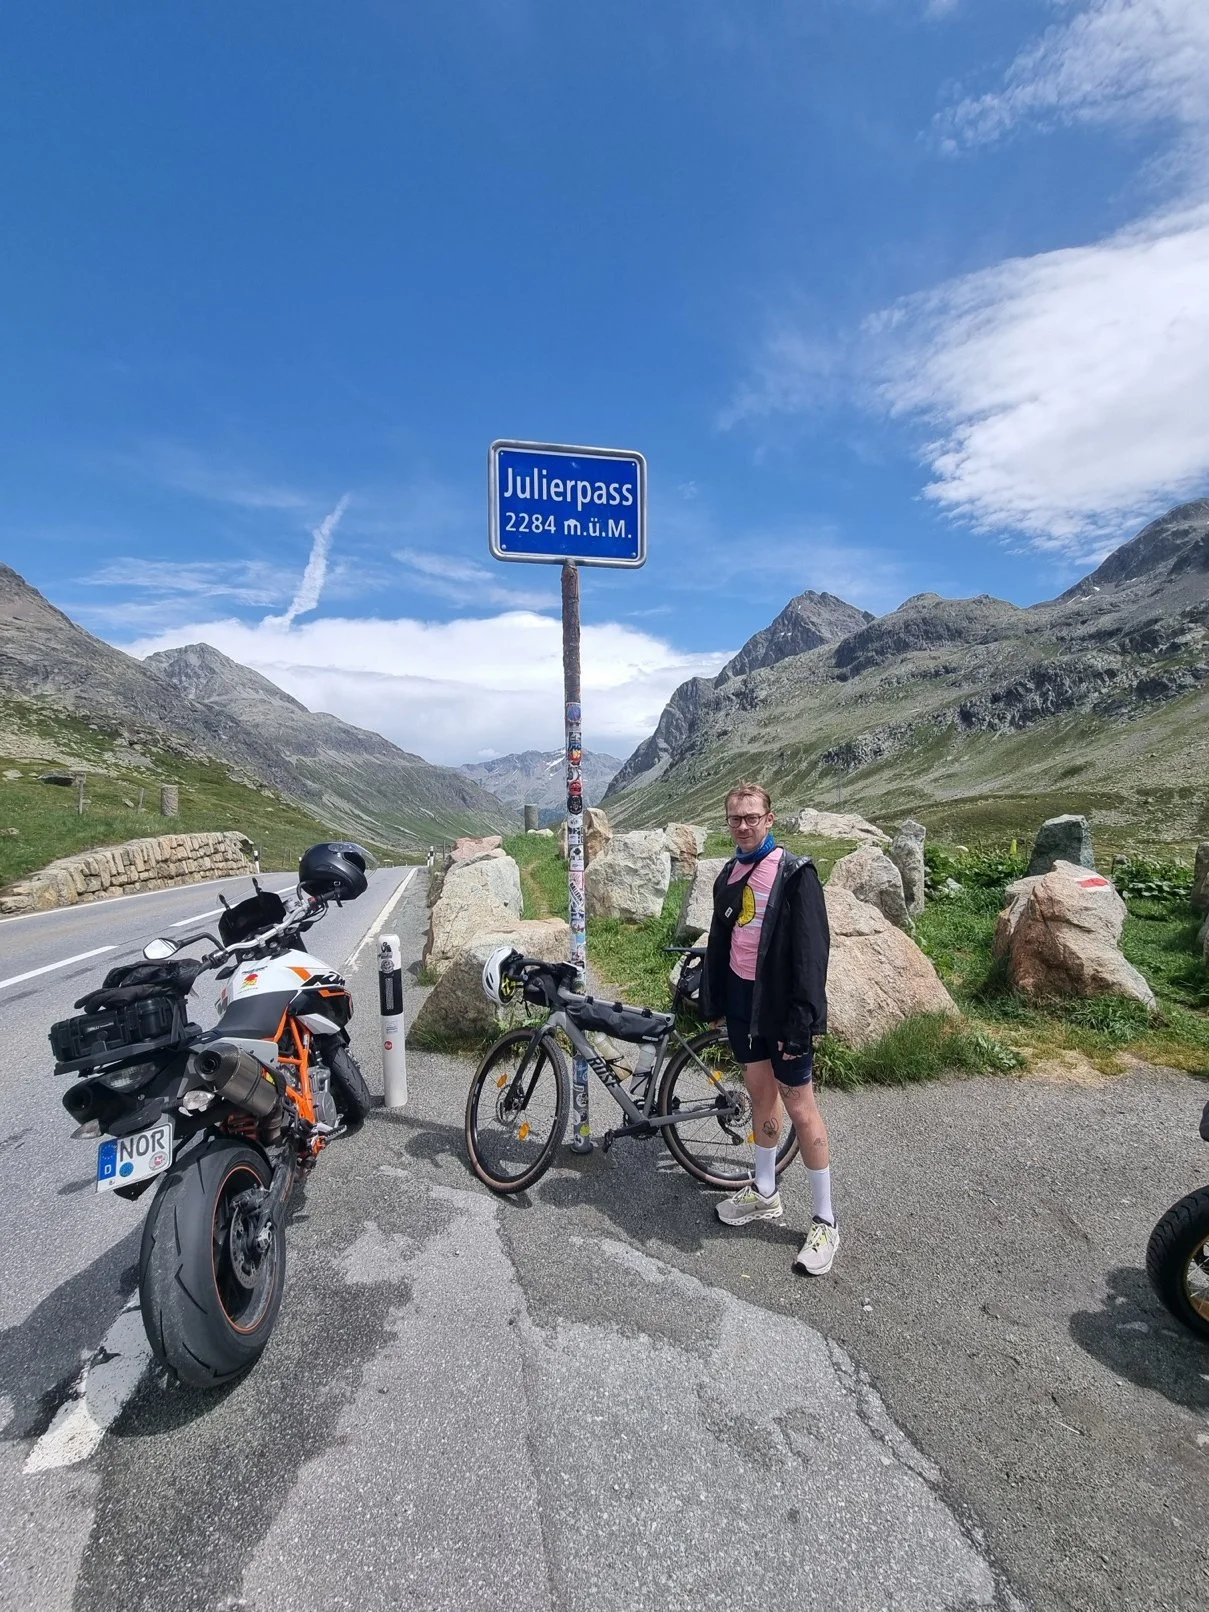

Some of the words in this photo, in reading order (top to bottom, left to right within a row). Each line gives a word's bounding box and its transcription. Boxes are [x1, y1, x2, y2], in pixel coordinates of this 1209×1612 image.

[504, 467, 633, 511] Julierpass
[505, 512, 556, 534] 2284
[564, 517, 632, 538] m.ü.M.
[120, 1129, 165, 1162] NOR
[104, 1164, 112, 1175] D
